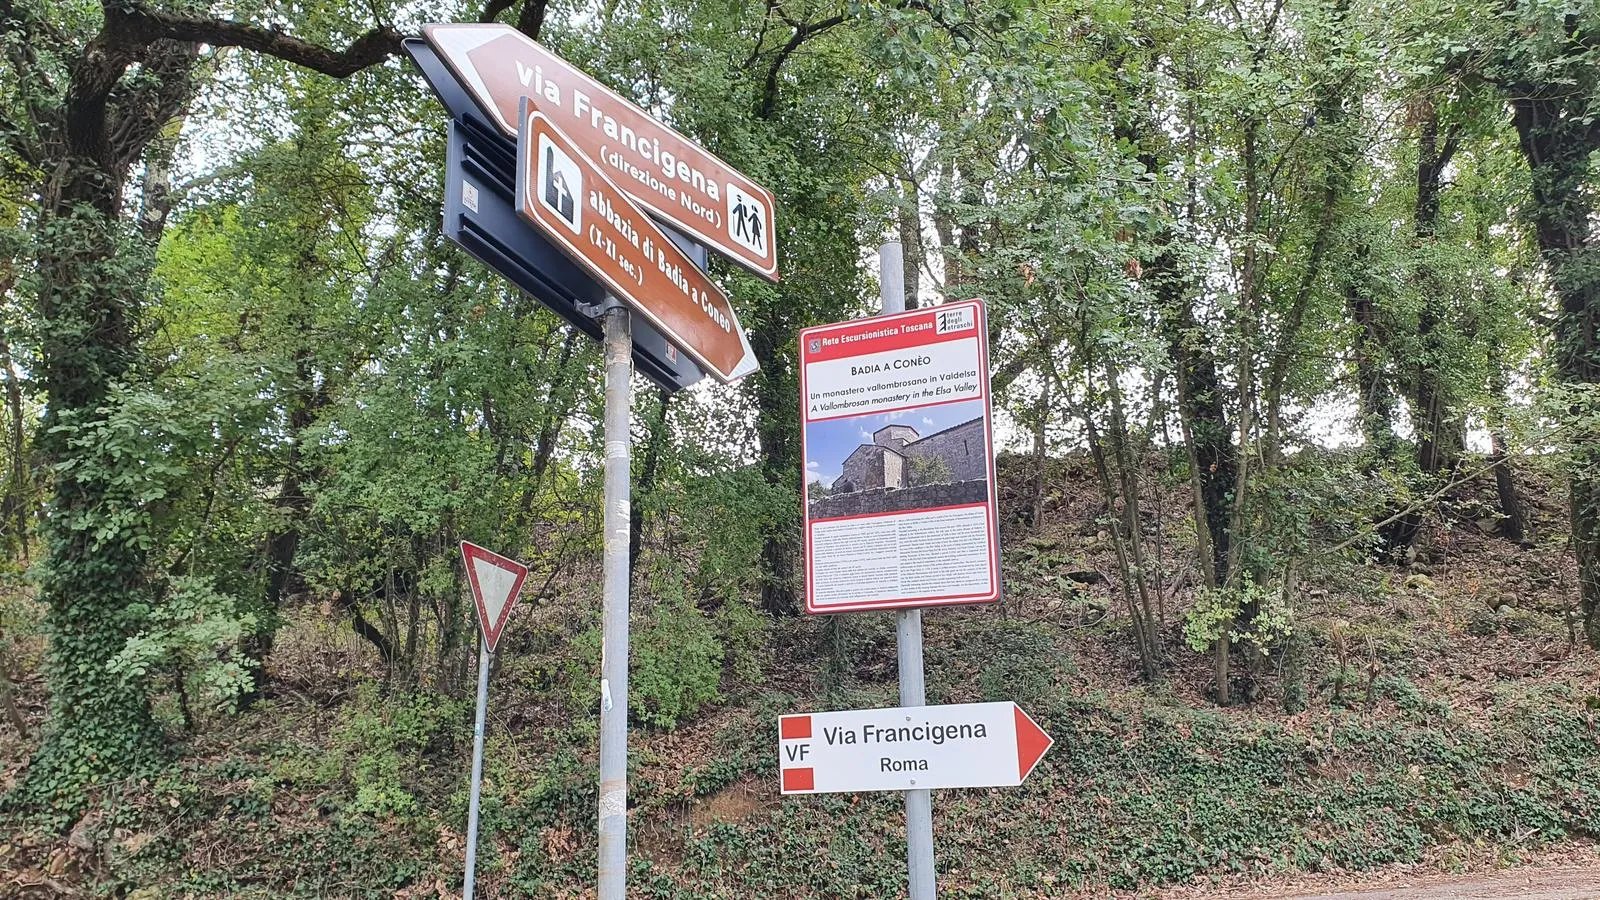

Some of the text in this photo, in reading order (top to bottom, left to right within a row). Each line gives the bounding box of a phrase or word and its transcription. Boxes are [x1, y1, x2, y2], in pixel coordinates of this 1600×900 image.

[515, 60, 720, 202] via Francigena
[600, 145, 722, 229] (direzione Nord)
[589, 223, 643, 287] (X-XI sec.)
[589, 190, 731, 334] abbazia di Badia a Coneo
[822, 321, 934, 347] Rete Escursionistica Toscana
[851, 355, 932, 376] BADIA A CONÈO
[810, 369, 977, 400] Un monastero vallombrosano in Valdelsa
[811, 382, 978, 413] A Vallombrosan monastery in the Elsa Valley
[823, 721, 987, 746] Via Francigena
[785, 743, 811, 762] VF
[880, 757, 929, 772] Roma
